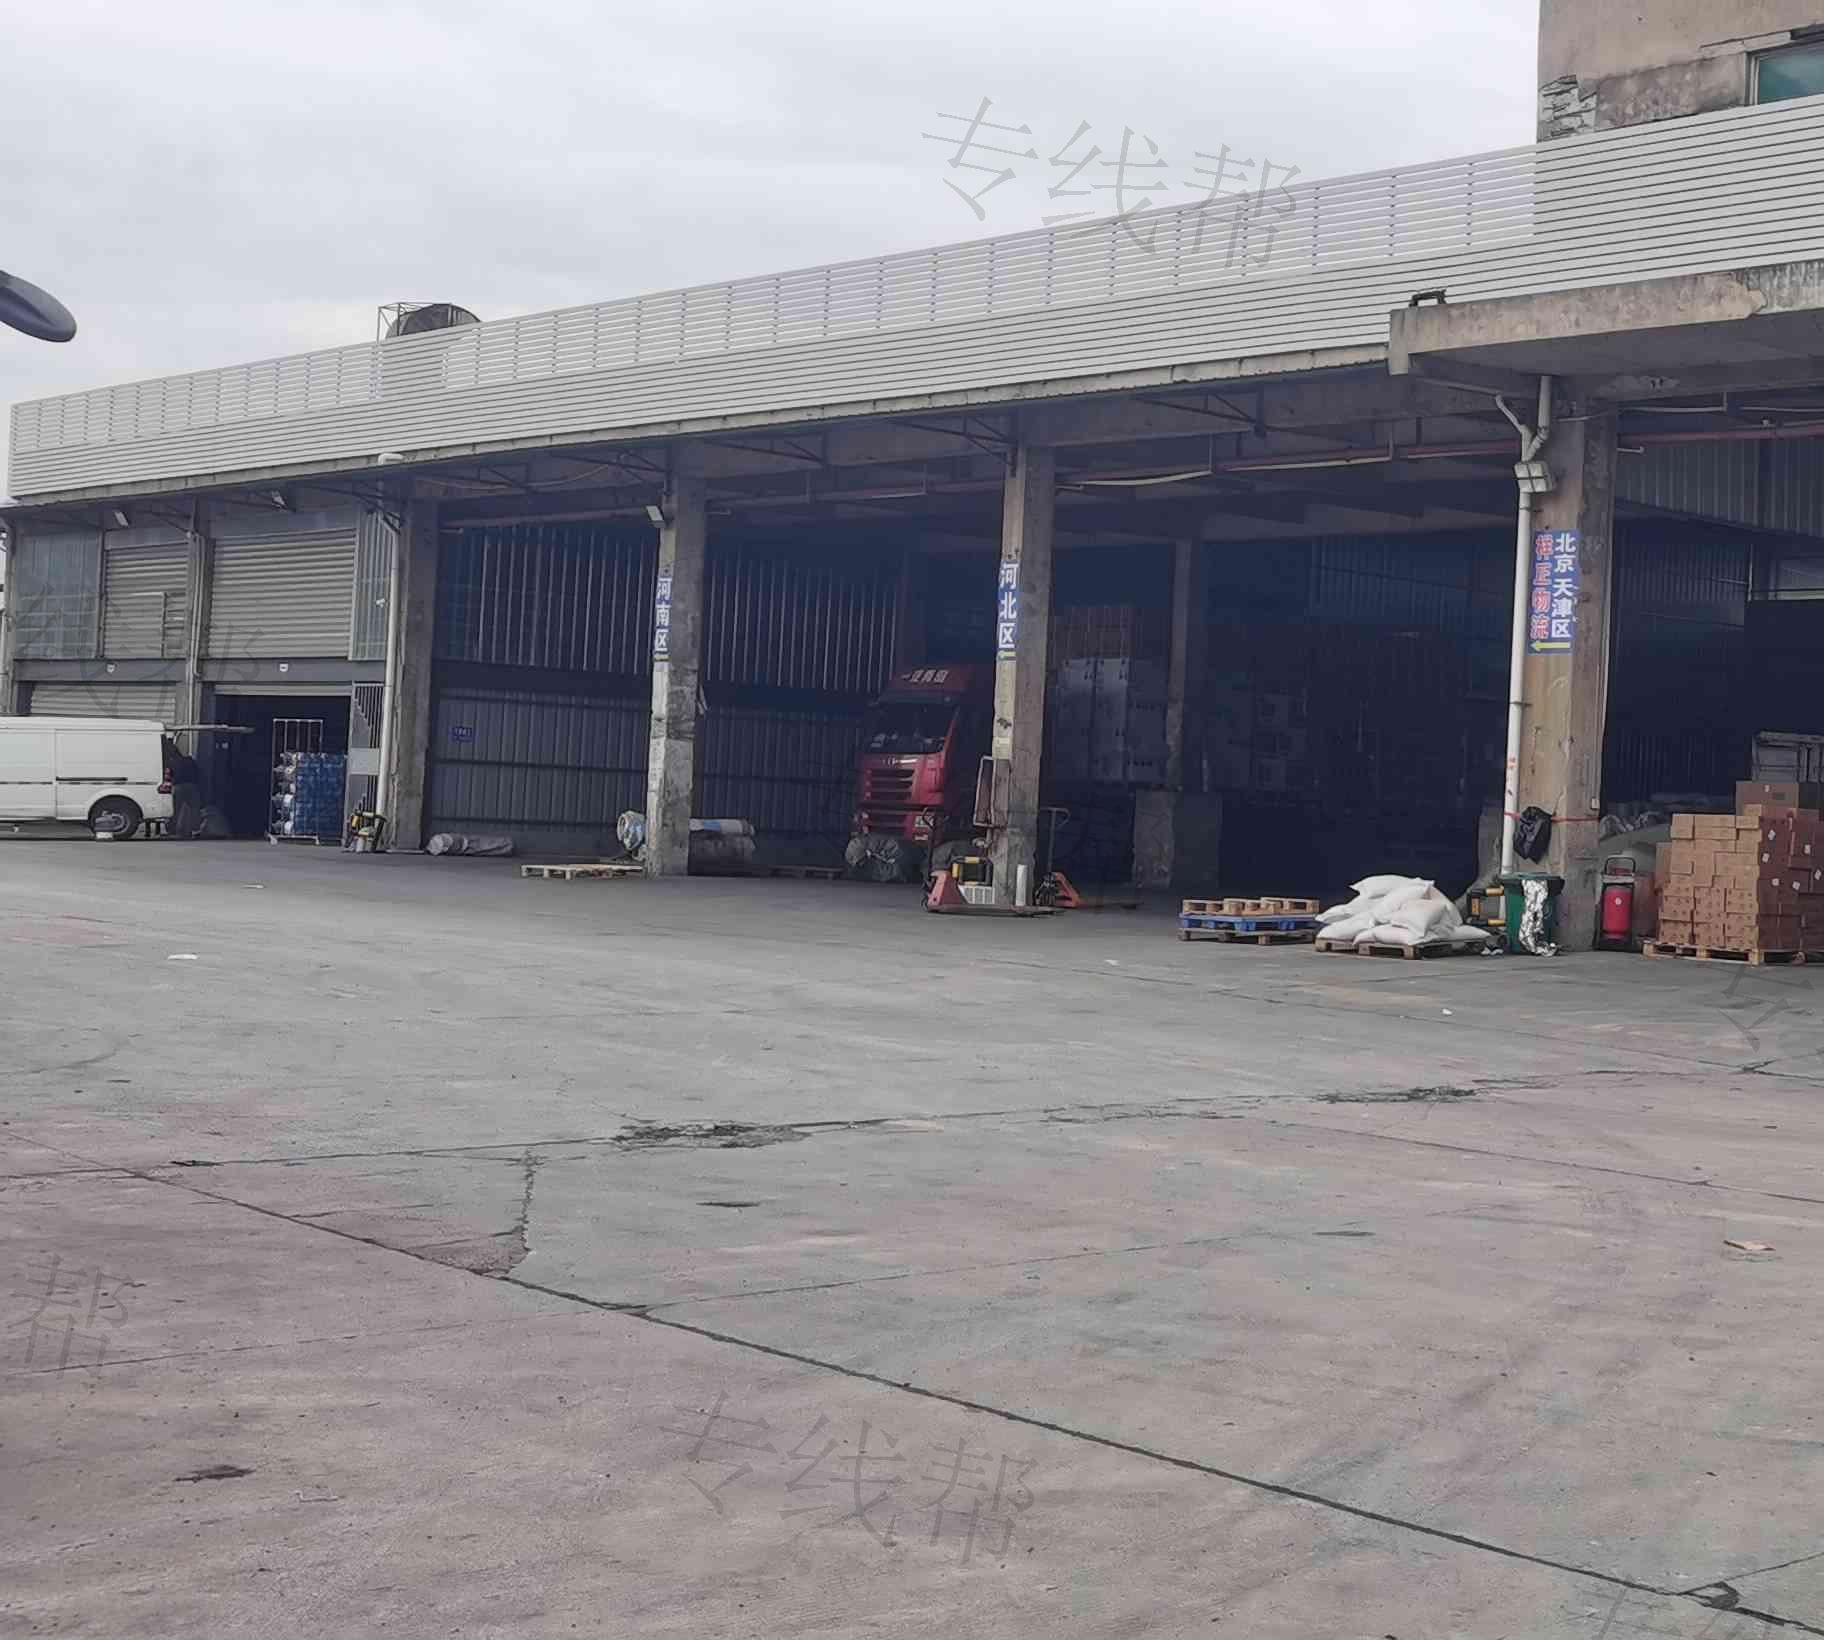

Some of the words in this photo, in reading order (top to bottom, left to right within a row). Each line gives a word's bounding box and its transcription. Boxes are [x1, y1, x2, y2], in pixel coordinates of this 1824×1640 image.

[999, 562, 1019, 648] 河北区
[1530, 534, 1553, 640] 祥正物流
[1551, 533, 1576, 638] 北京天津区
